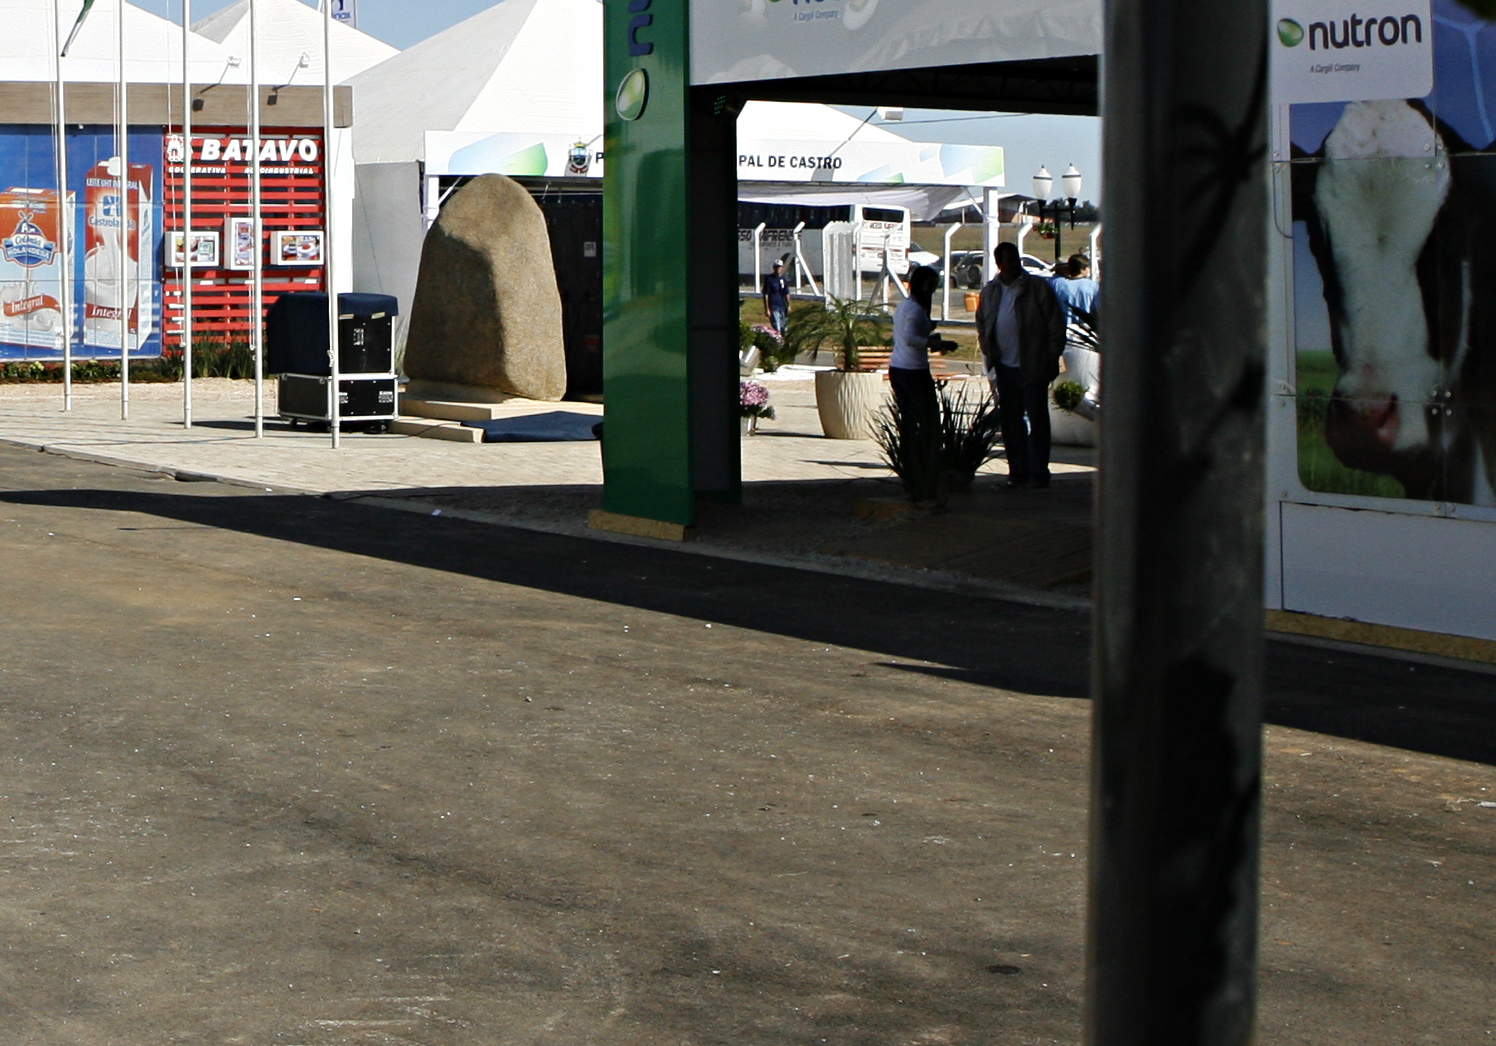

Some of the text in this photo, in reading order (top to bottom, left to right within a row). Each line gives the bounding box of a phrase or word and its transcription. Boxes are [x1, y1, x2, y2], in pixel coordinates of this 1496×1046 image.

[1308, 13, 1422, 51] nutron
[200, 138, 319, 162] BATAVO
[768, 156, 785, 169] DE
[790, 156, 843, 170] CASTRO
[11, 295, 44, 313] Integral
[91, 305, 133, 320] Integrl
